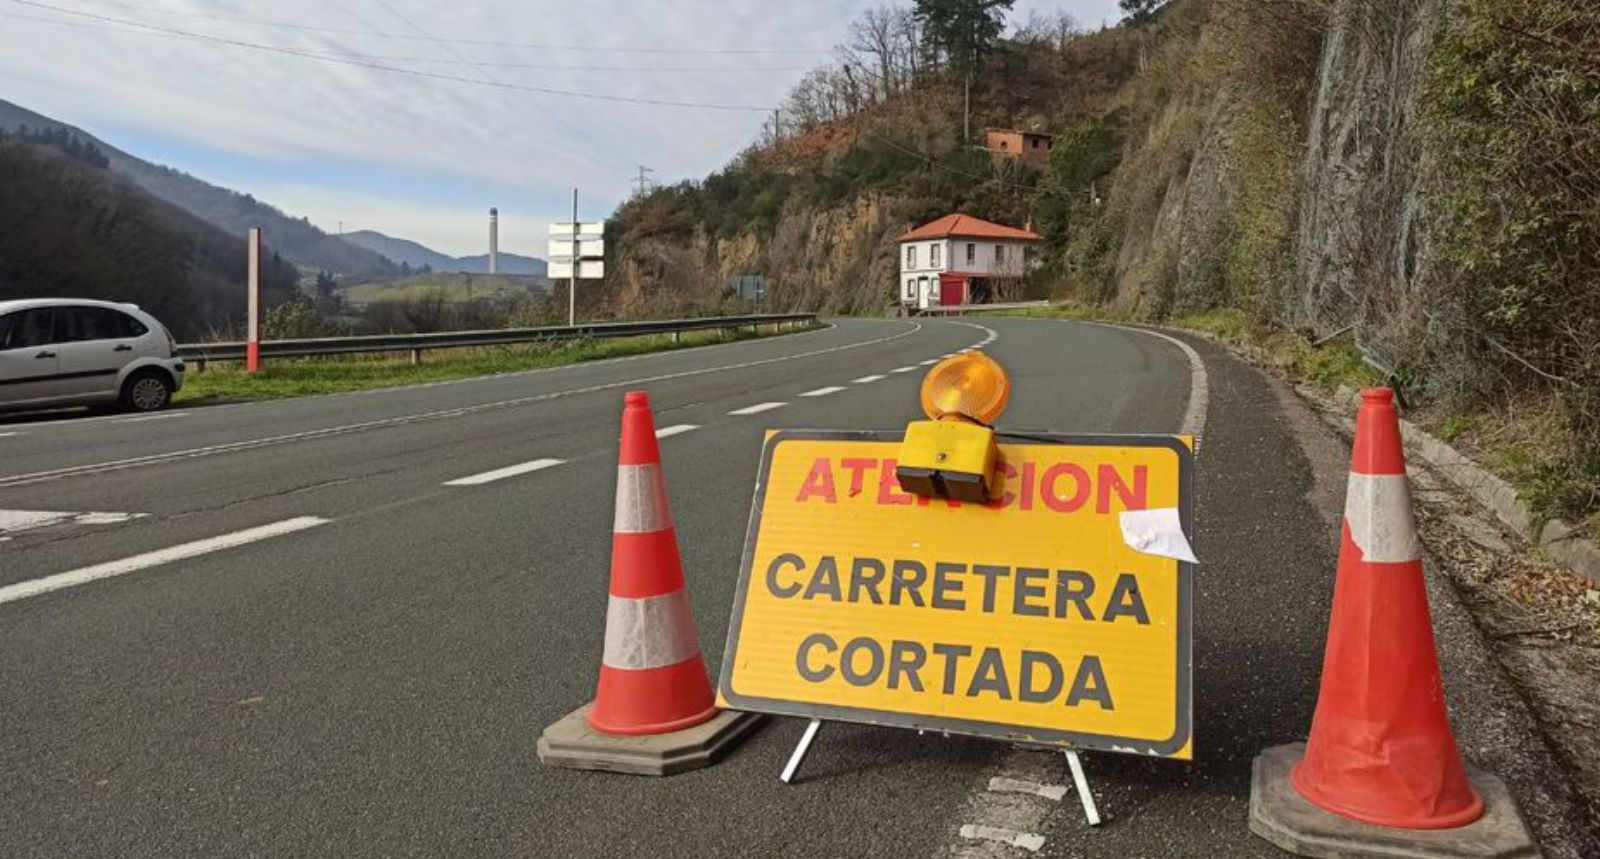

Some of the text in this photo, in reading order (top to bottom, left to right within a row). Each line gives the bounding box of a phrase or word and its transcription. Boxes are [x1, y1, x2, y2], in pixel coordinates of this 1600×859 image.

[796, 457, 1148, 514] ATECION
[766, 553, 1151, 625] CARRETERA
[796, 634, 1115, 711] CORTADA
